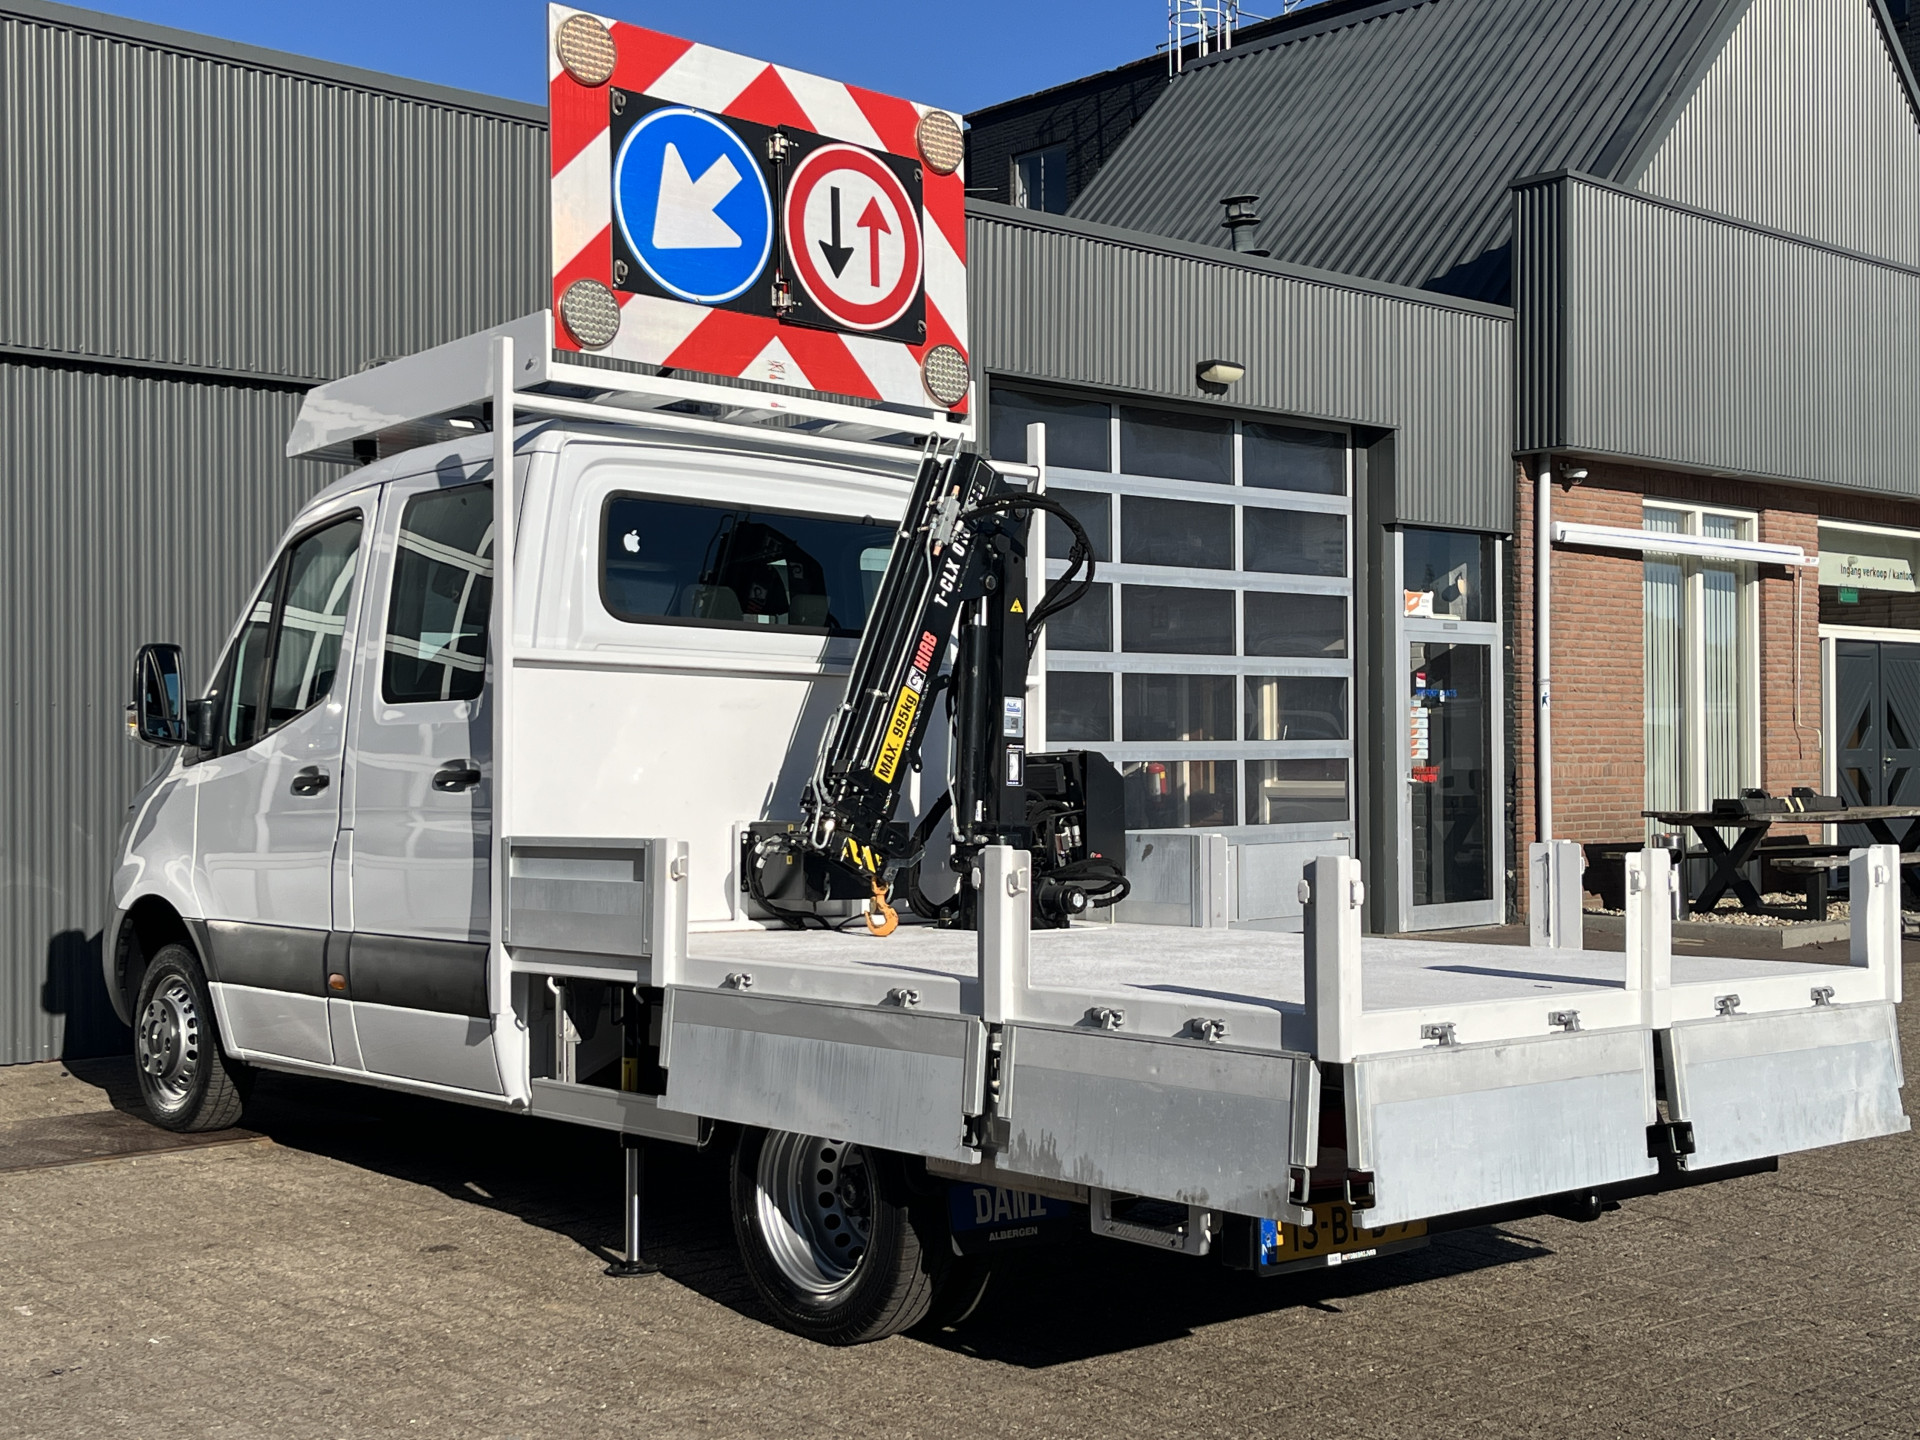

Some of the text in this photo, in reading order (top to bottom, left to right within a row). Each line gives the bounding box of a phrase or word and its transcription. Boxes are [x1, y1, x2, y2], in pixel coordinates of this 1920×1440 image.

[934, 558, 961, 607] T-CLX
[1840, 563, 1862, 579] Ingang
[1862, 567, 1887, 581] verkoop
[1892, 569, 1915, 581] kantoor
[913, 630, 938, 672] HIAB
[878, 694, 917, 778] MAX. 995kg
[973, 1186, 1047, 1225] DANI
[988, 1226, 1038, 1242] ALBERGEN
